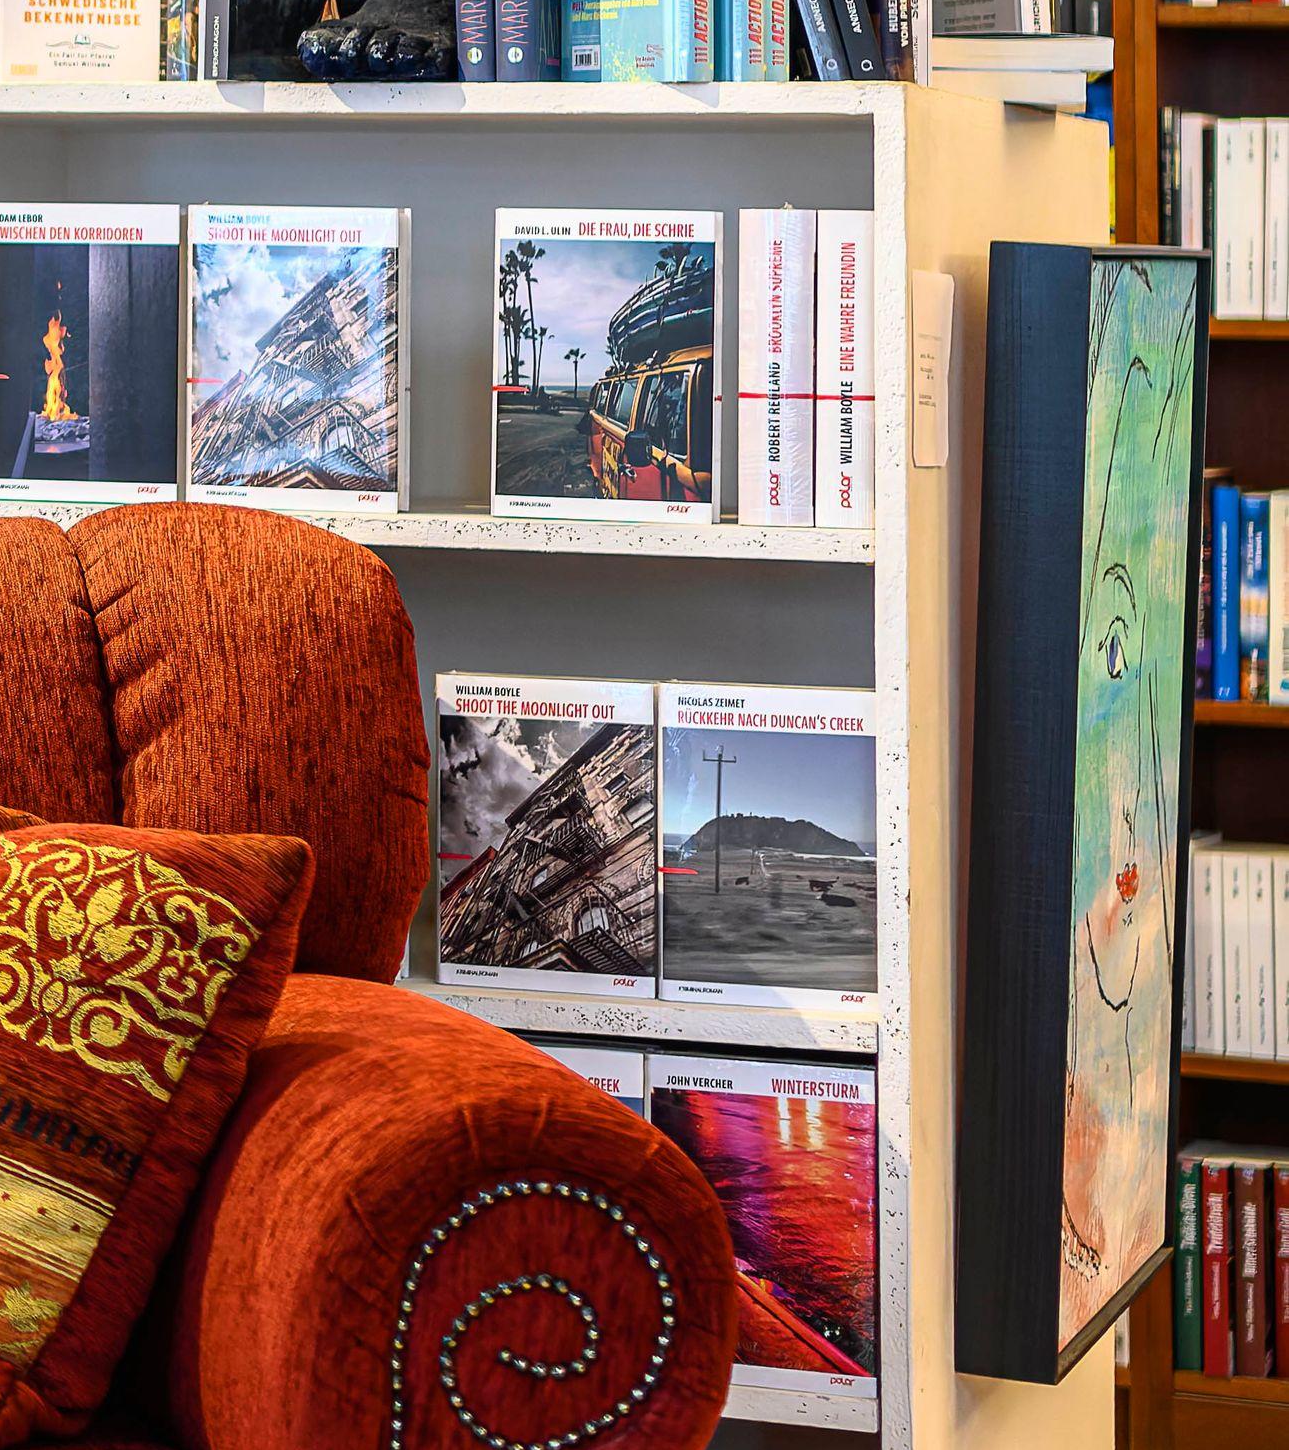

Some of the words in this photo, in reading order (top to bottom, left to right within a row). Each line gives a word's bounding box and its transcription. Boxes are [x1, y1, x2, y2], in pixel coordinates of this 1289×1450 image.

[24, 12, 141, 26] BEKENNTNISSE
[19, 214, 43, 223] LEBOR
[49, 227, 70, 240] DEN
[74, 227, 143, 241] KORRIDOREN
[515, 225, 540, 235] DAVID
[552, 226, 571, 236] ULIN
[578, 222, 597, 237] DIE
[634, 224, 652, 238] DIE
[655, 224, 695, 238] SCHRIE
[843, 241, 856, 300] FREUNDIN
[842, 304, 855, 341] WAHRE
[841, 345, 853, 372] EINE
[456, 685, 492, 696] WILLIAM
[494, 688, 520, 697] BOYLE
[456, 698, 494, 714] SHOOT
[497, 701, 518, 715] THE
[520, 702, 588, 718] MOONLIGHT
[592, 704, 615, 719] OUT
[678, 696, 713, 707] NICOLAS
[716, 698, 745, 708] ZEIMET
[677, 709, 735, 726] RÜCKKEHR
[737, 713, 768, 728] NACH
[771, 713, 827, 730] DUNCAN'S
[830, 716, 864, 732] CREEK
[667, 1075, 691, 1088] JOHN
[693, 1076, 733, 1090] VERCHER
[771, 1077, 860, 1100] WINTERSTURM
